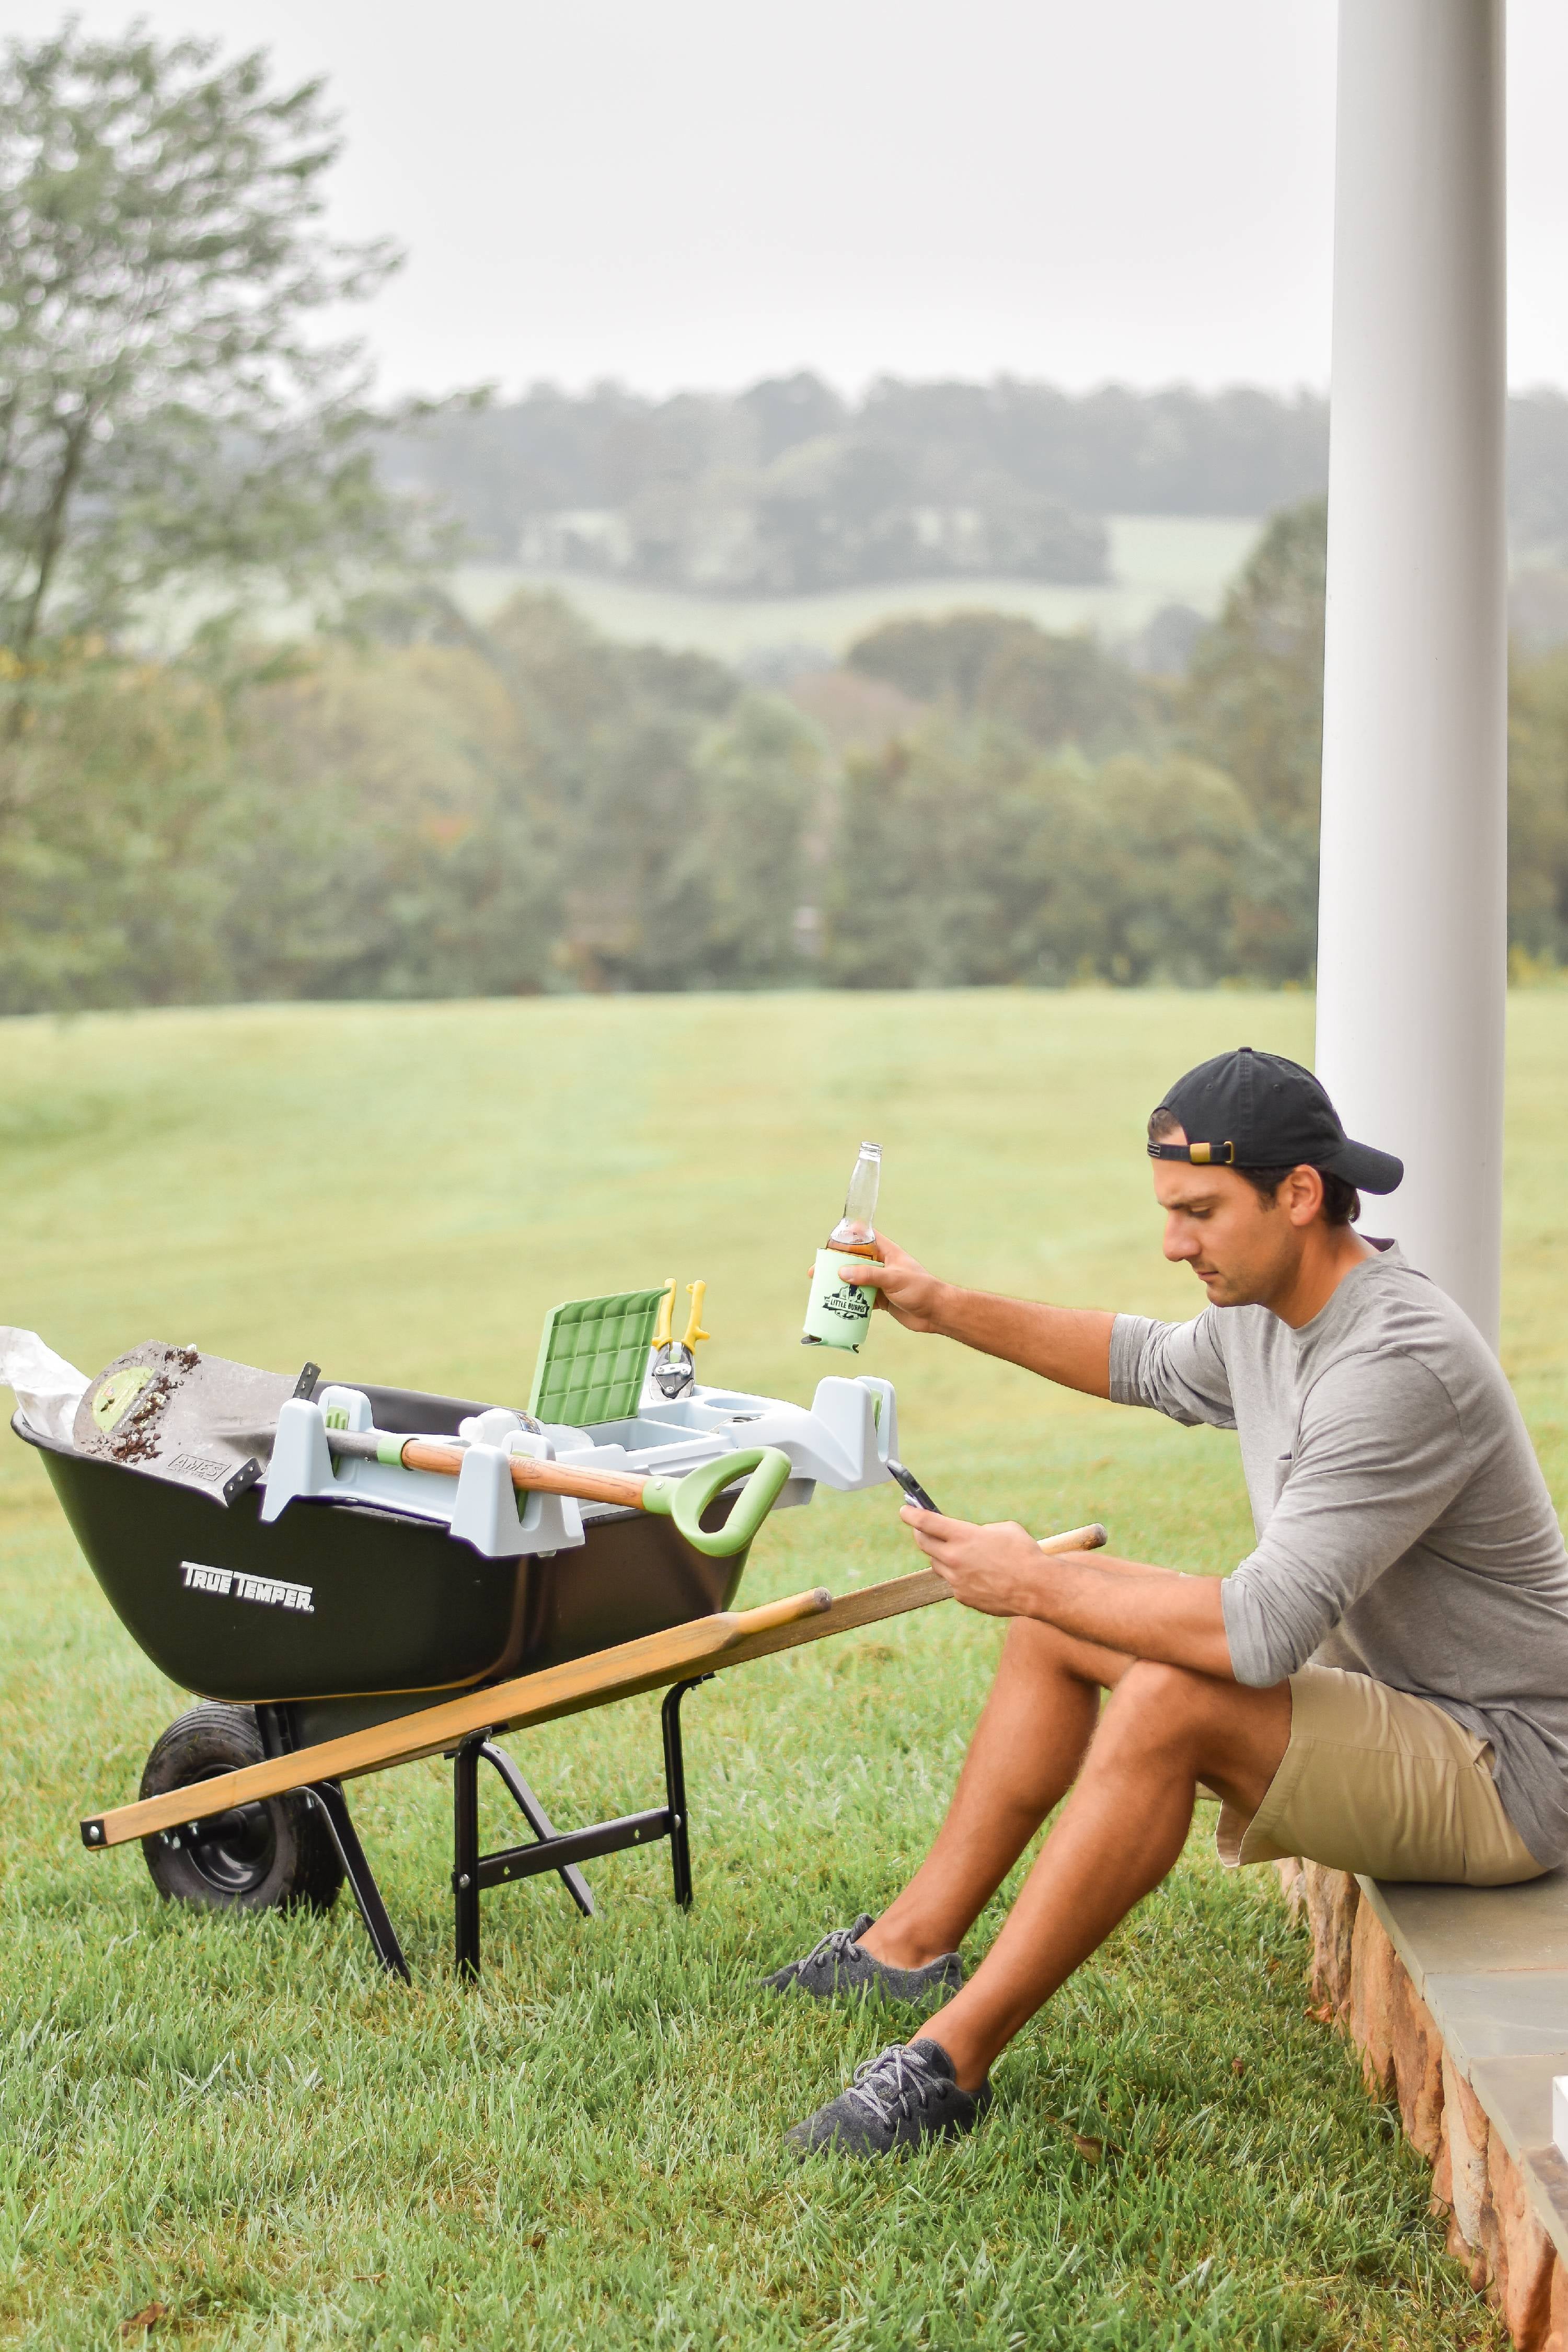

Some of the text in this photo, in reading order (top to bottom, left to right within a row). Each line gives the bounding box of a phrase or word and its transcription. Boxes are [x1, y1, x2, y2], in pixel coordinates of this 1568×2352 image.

[831, 1298, 866, 1312] LITTLE BURROS
[175, 1457, 223, 1477] AMES
[182, 1561, 233, 1594] TRUE
